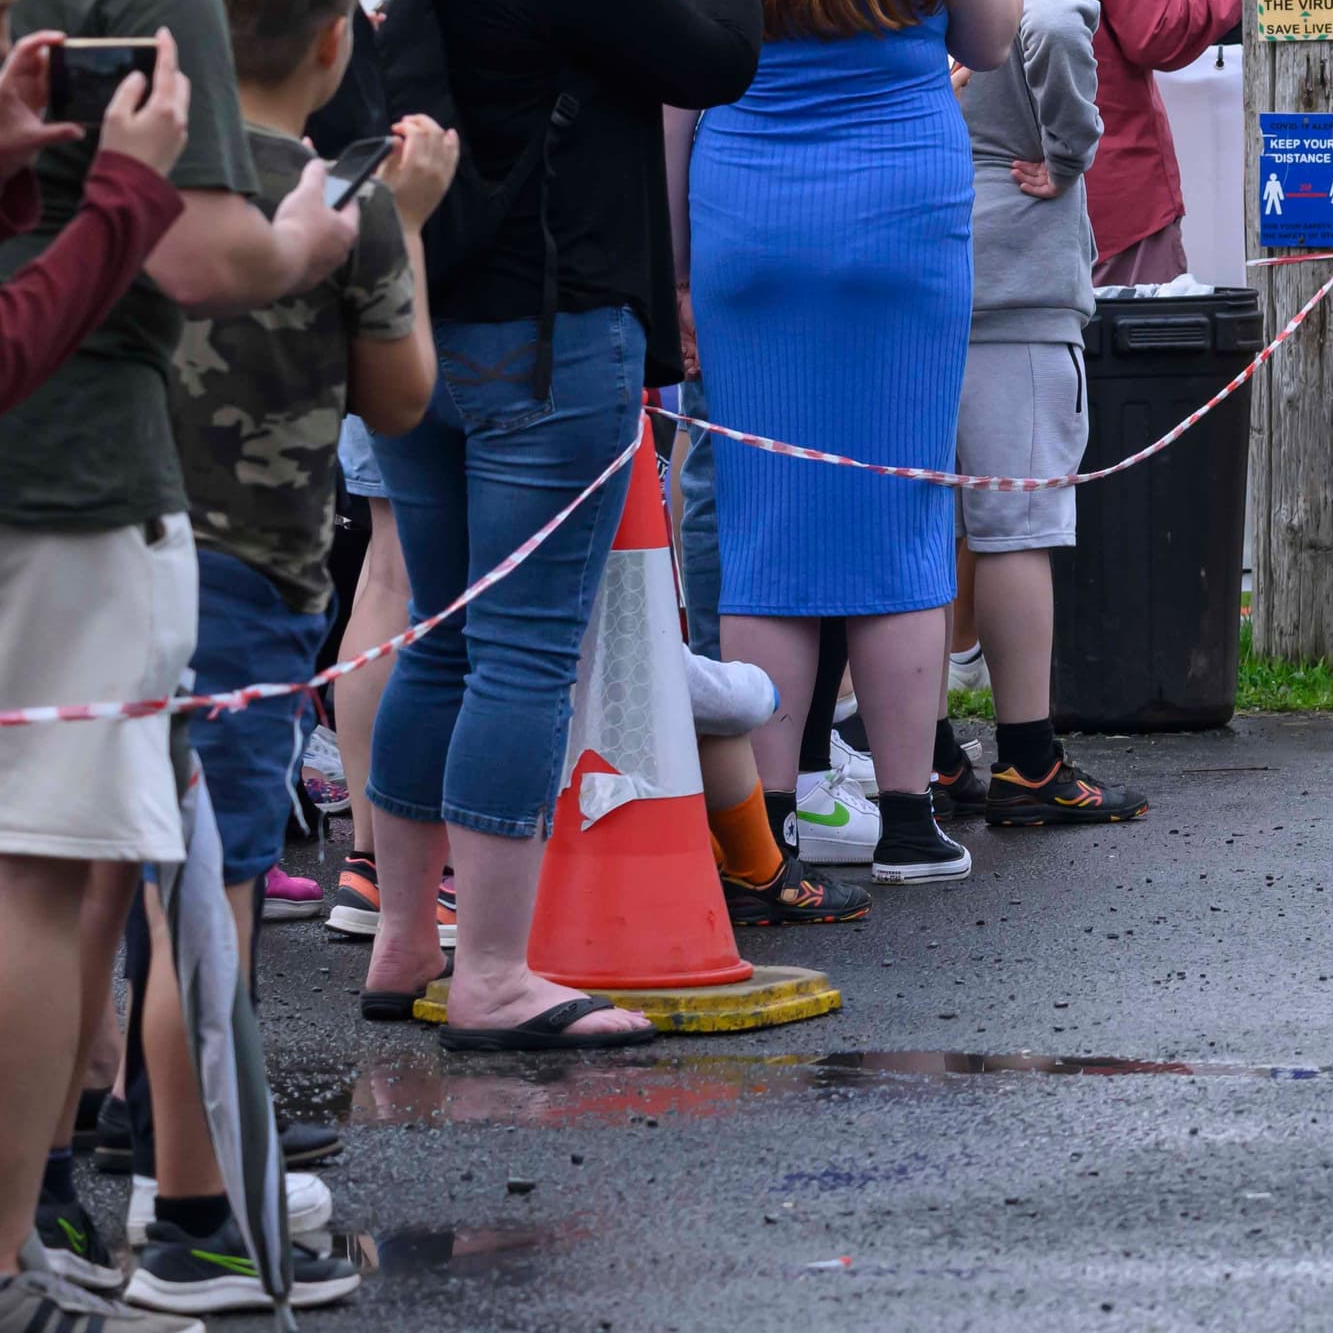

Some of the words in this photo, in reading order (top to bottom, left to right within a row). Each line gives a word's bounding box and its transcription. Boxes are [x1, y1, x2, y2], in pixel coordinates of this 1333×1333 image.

[1264, 0, 1294, 11] THE
[1267, 24, 1300, 35] SAVE
[1270, 139, 1300, 149] KEEP
[1275, 153, 1331, 163] DISTANCE
